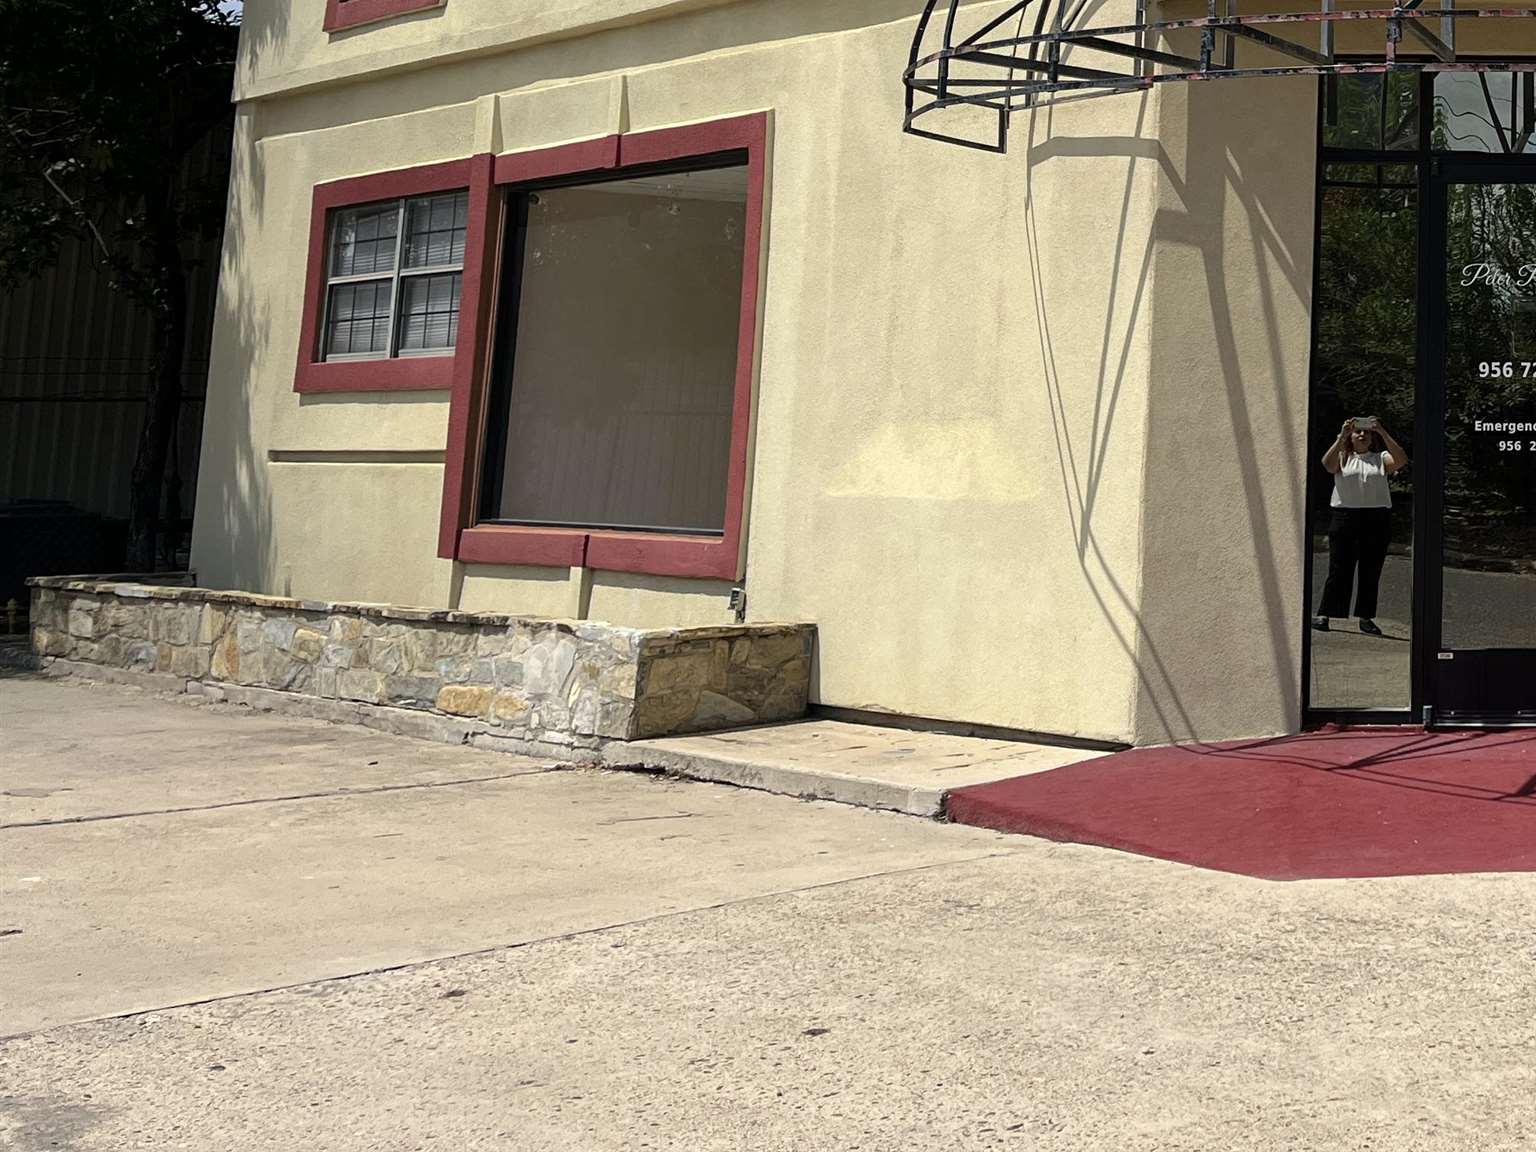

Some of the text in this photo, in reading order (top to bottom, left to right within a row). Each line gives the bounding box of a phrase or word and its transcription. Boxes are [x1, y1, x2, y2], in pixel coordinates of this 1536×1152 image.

[1461, 263, 1511, 287] Peter
[1478, 362, 1513, 378] 956
[1499, 441, 1522, 452] 956
